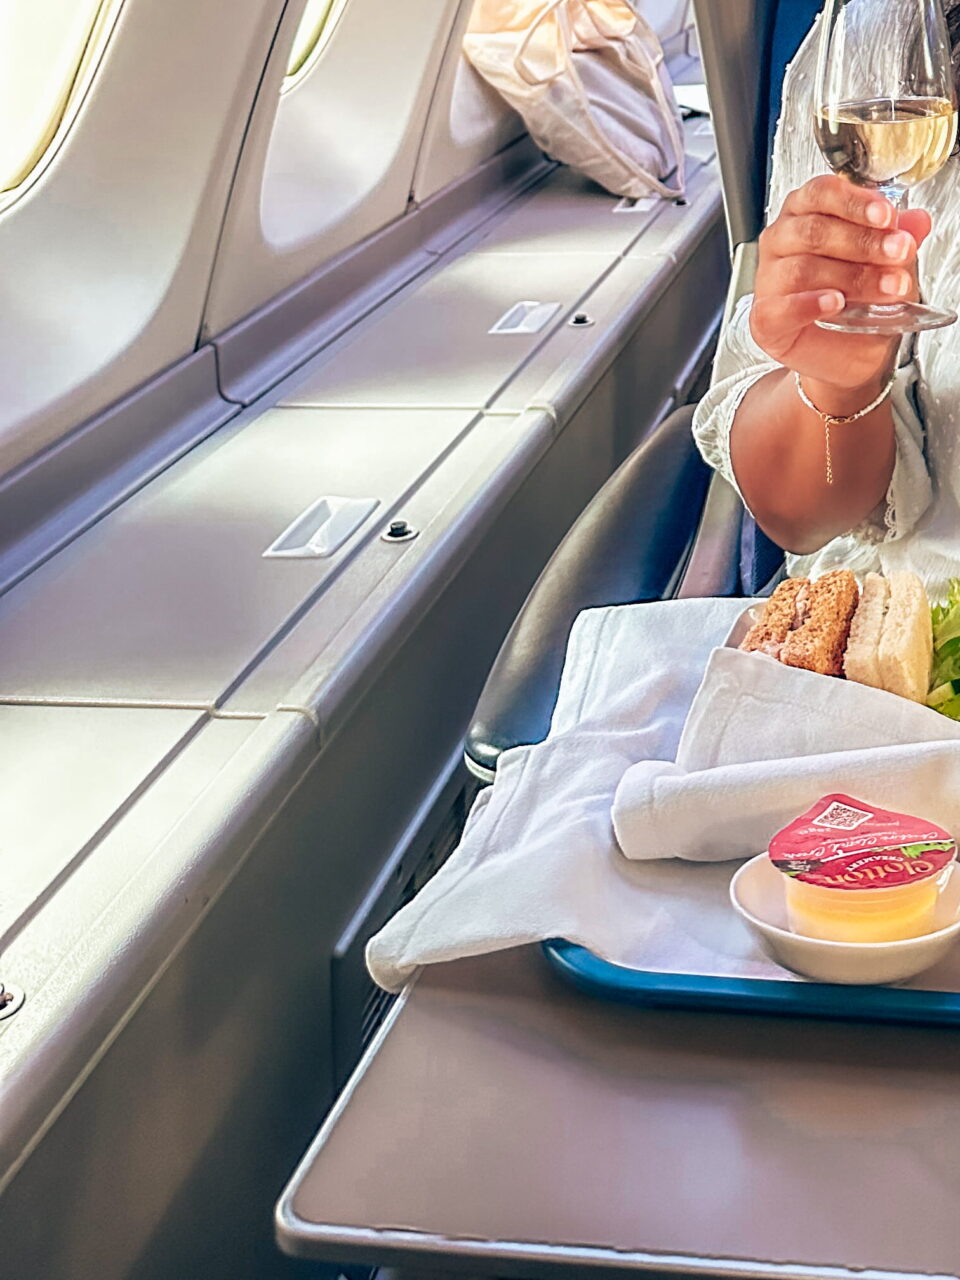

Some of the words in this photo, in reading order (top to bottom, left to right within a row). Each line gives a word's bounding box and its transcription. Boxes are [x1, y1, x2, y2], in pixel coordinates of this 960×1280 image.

[781, 846, 825, 858] Cream
[828, 837, 877, 852] Clotted
[846, 854, 904, 871] CREAMERY
[823, 860, 934, 884] Clotton
